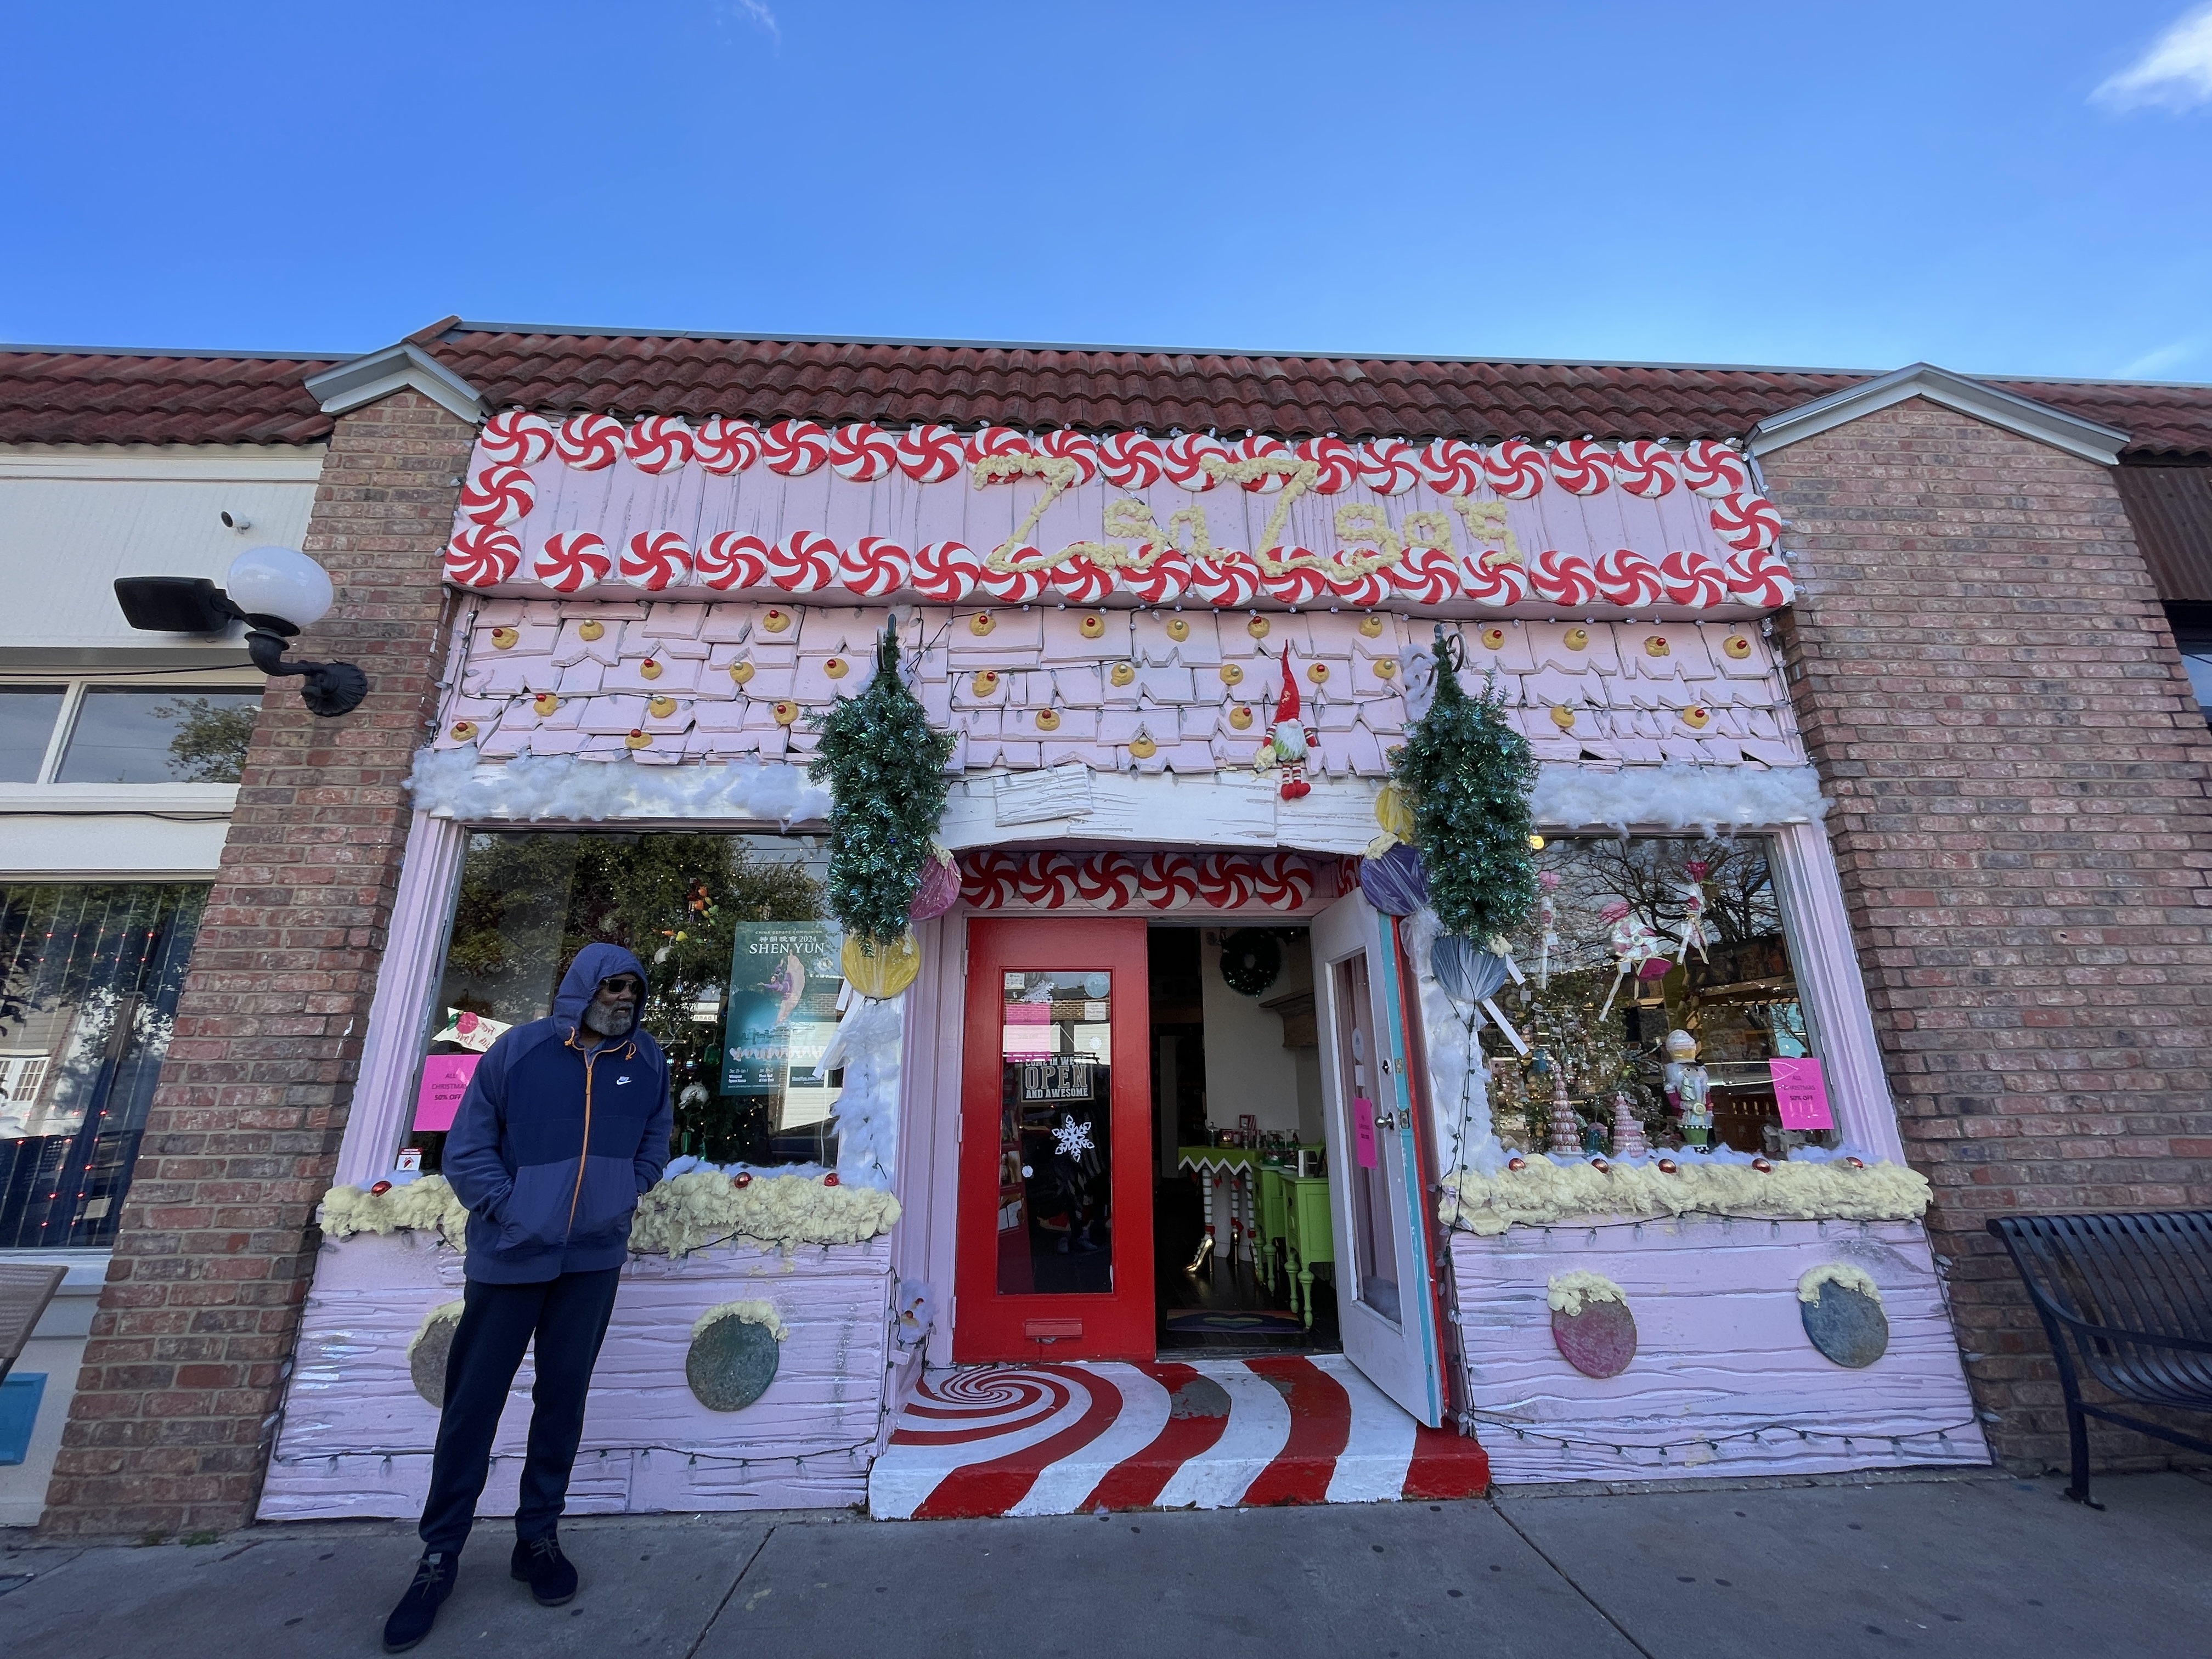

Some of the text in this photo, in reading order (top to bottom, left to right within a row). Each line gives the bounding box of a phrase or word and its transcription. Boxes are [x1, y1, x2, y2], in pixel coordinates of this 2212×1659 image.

[749, 942, 825, 955] SHEN YUN
[1025, 1064, 1088, 1090] OPEN
[1025, 1087, 1088, 1099] AND AWESOME
